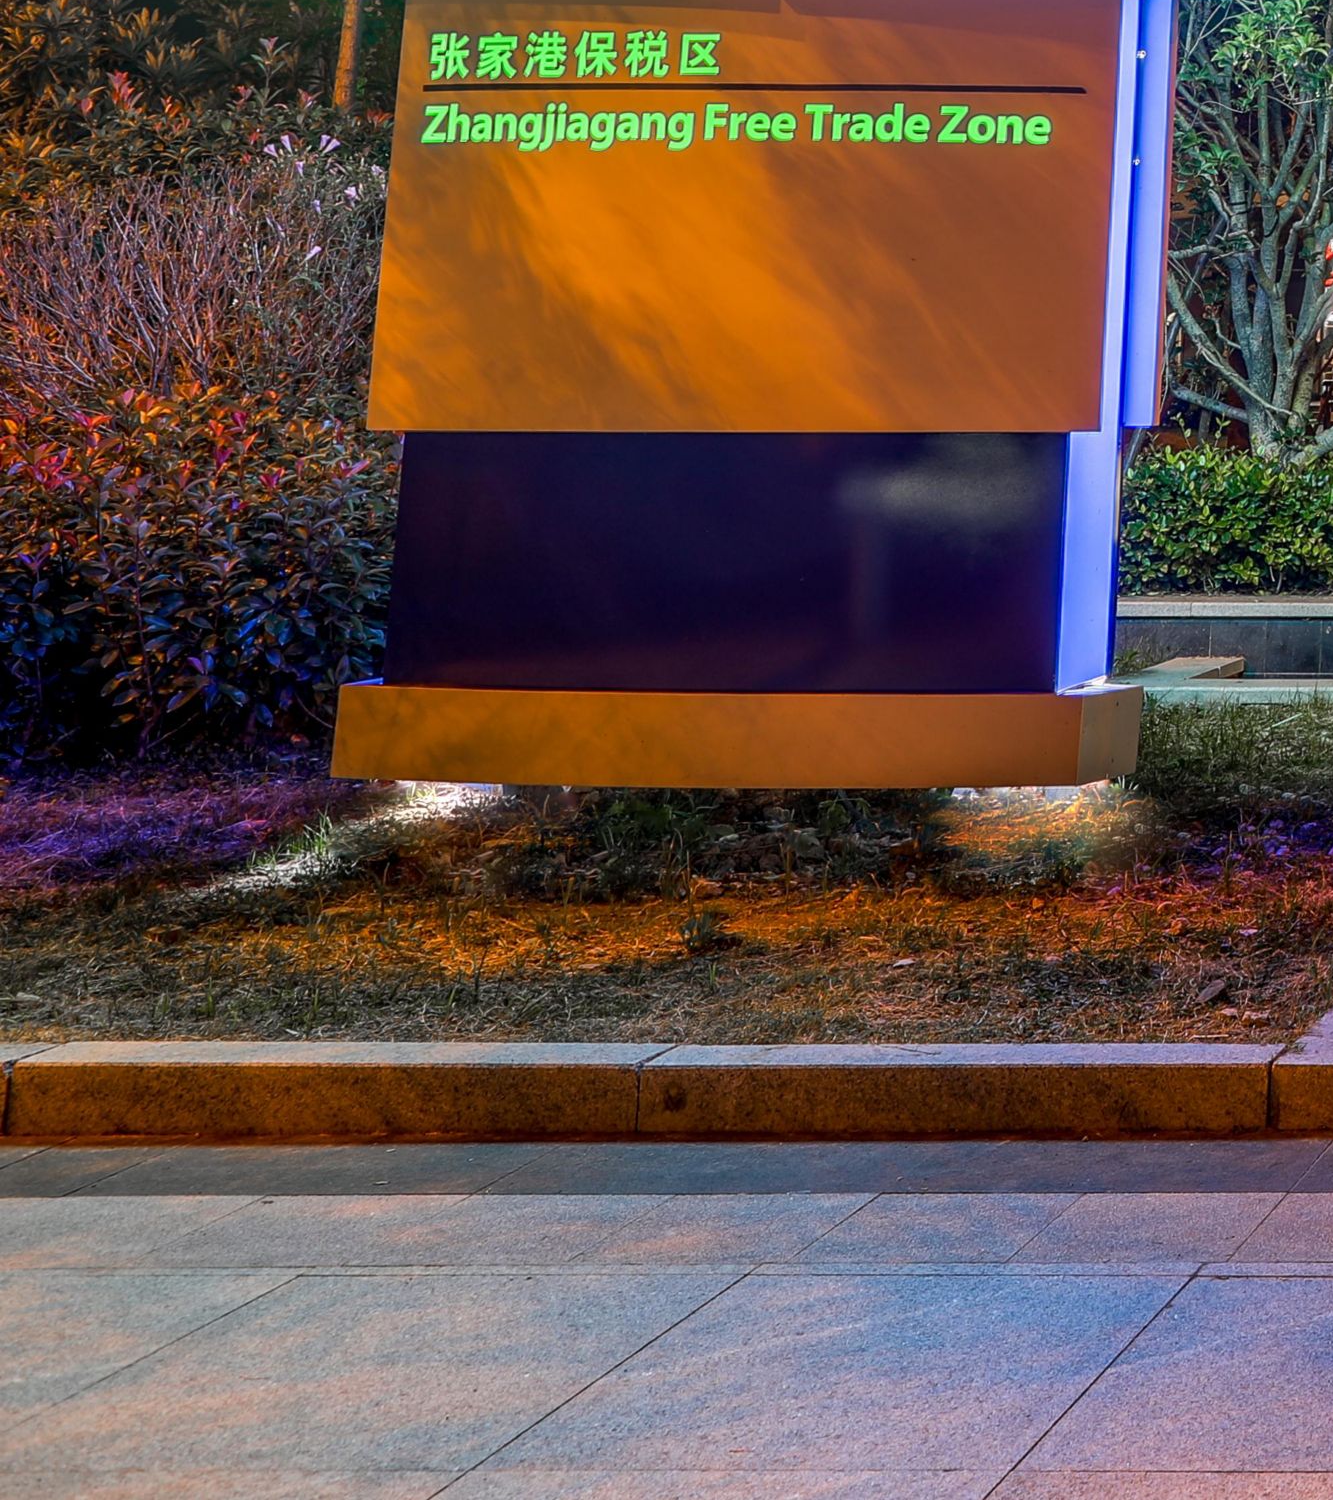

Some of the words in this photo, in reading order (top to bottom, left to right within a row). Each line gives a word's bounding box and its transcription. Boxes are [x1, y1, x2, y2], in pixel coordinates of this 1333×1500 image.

[429, 30, 723, 81] 张家港保税区
[420, 102, 696, 153] Zhangjiagang
[703, 102, 797, 143] Free
[803, 102, 930, 143] Trade
[936, 104, 1053, 147] Zone
